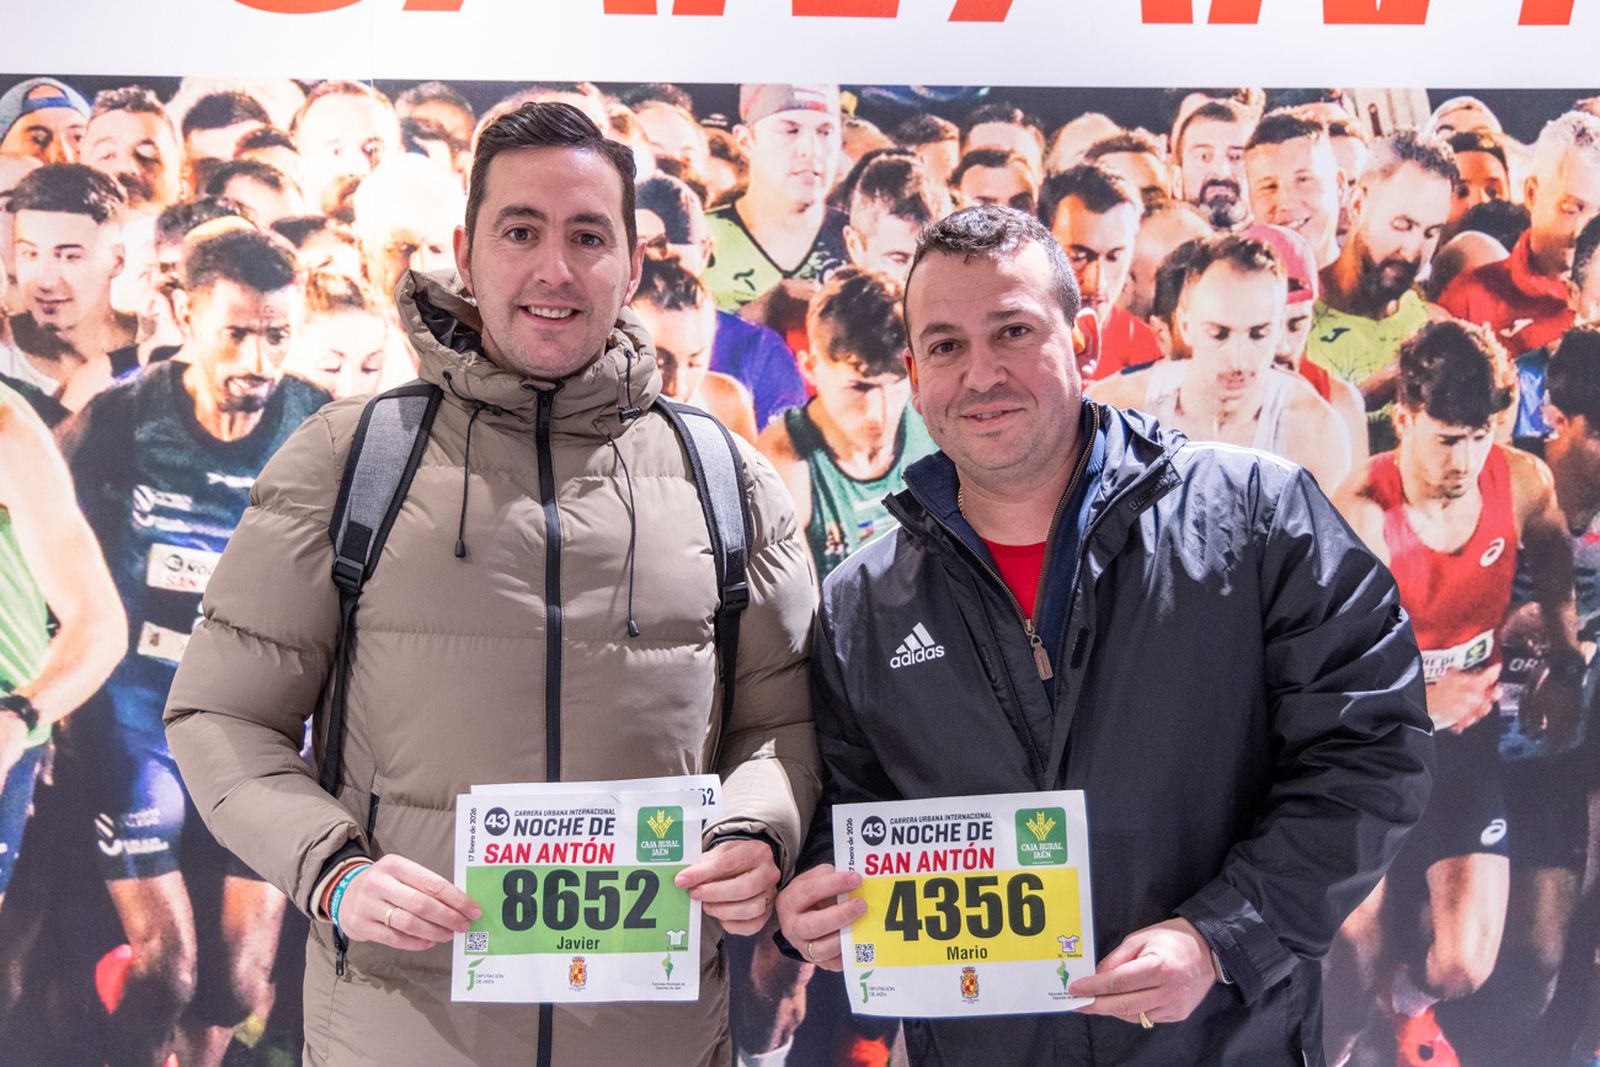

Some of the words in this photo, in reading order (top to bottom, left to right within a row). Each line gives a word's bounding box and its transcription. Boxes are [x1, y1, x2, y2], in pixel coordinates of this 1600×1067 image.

[889, 645, 945, 669] adidas
[469, 807, 477, 824] 2026
[514, 808, 543, 817] CARRERA
[544, 808, 568, 817] URBANA
[569, 807, 616, 816] INTERNACIONAL
[889, 816, 918, 825] CARRERA
[918, 814, 943, 823] URBANA
[944, 811, 992, 821] INTERNACIONAL
[485, 813, 508, 828] 43
[513, 817, 584, 836] NOCHE
[588, 817, 616, 836] DE
[846, 817, 854, 836] 2026
[469, 825, 476, 834] de
[862, 822, 885, 838] 43
[891, 823, 961, 846] NOCHE
[966, 821, 993, 842] DE
[847, 836, 854, 846] de
[1020, 843, 1039, 851] CAJA
[468, 854, 475, 862] 17
[484, 842, 532, 864] SAN
[535, 837, 615, 864] ANTÓN
[864, 851, 911, 876] SAN
[916, 842, 995, 873] ANTÓN
[501, 868, 660, 932] 8652
[884, 872, 1046, 942] 4356
[556, 936, 600, 951] Javier
[946, 945, 988, 961] Mario
